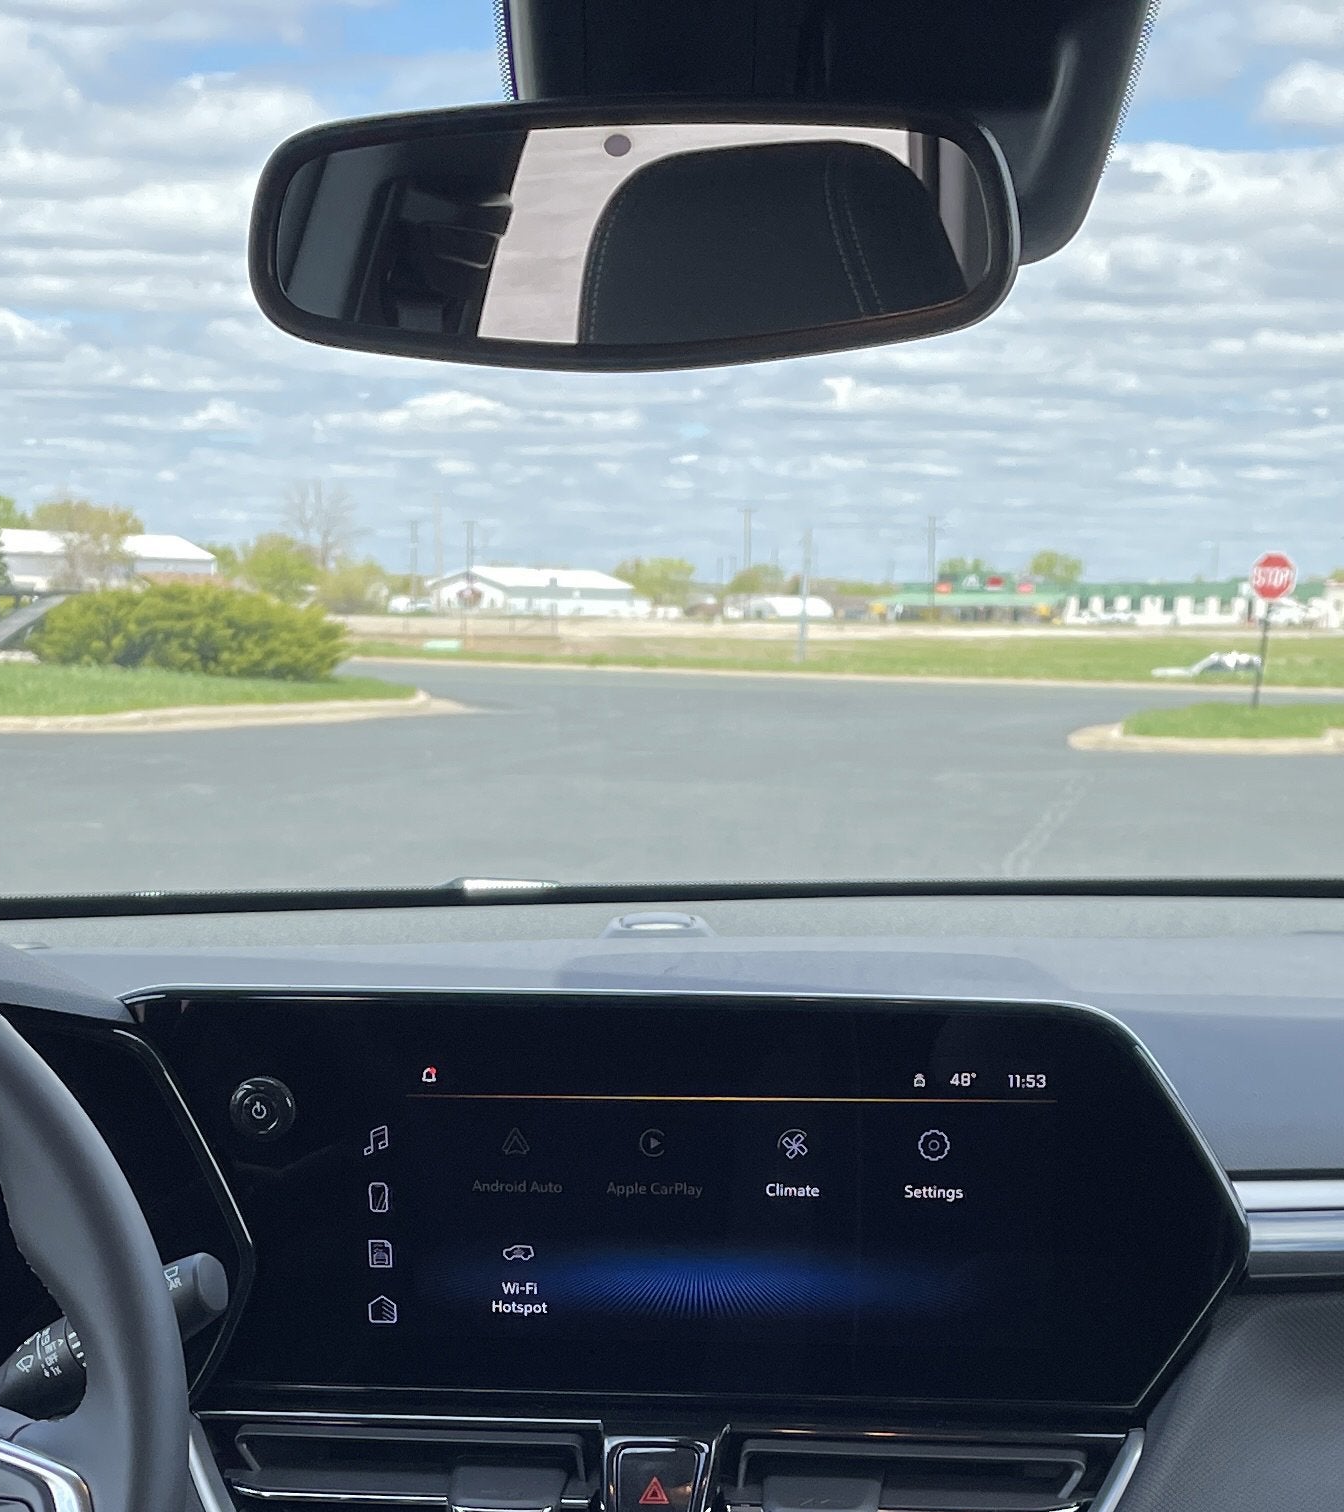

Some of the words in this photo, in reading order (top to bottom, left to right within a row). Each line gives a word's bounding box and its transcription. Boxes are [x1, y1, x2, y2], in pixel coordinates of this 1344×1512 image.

[1007, 1074, 1047, 1089] 11:53
[472, 1180, 529, 1194] Android
[532, 1181, 563, 1194] Auto
[607, 1182, 646, 1197] Apple
[651, 1182, 702, 1198] CarPlay
[765, 1182, 820, 1197] Climate
[904, 1184, 964, 1203] Settings
[501, 1281, 538, 1295] Wi-Fi
[491, 1299, 548, 1317] Hotspot
